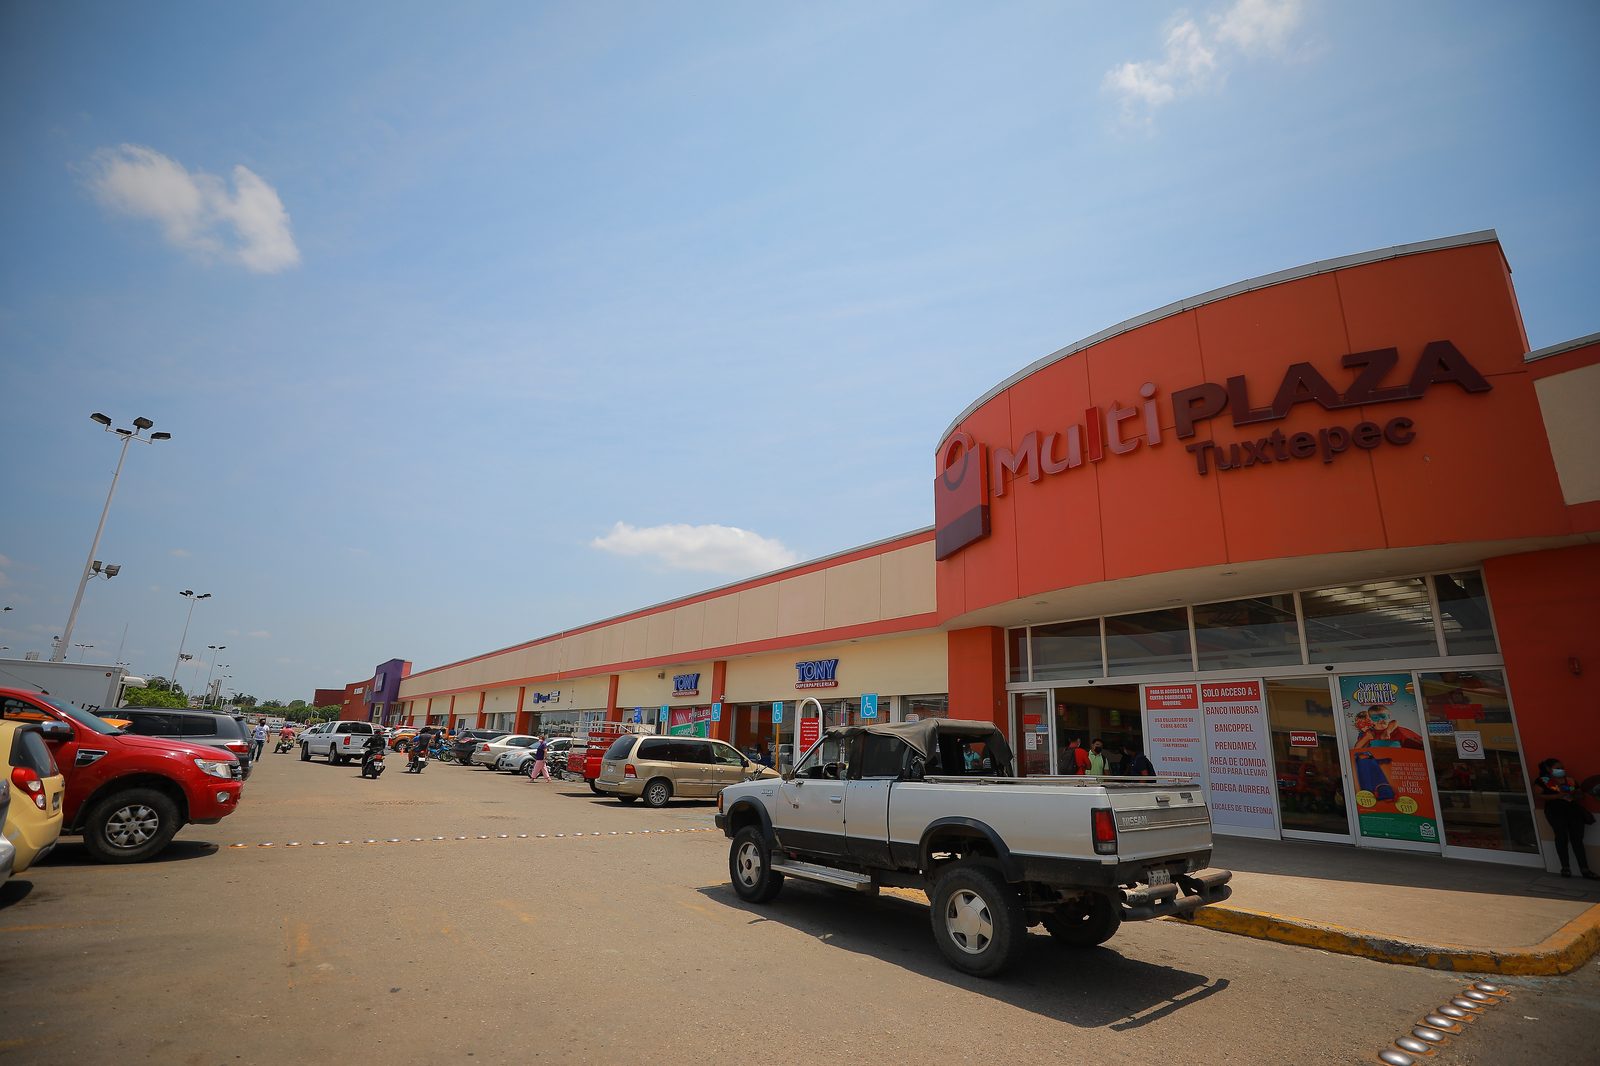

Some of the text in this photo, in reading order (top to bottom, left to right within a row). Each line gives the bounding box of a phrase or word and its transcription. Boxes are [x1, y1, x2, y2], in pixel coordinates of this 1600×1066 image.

[993, 340, 1492, 497] Multi PLAZA
[1186, 416, 1417, 476] Tuxtepec
[795, 658, 839, 681] TONY
[673, 673, 700, 690] TONY
[795, 681, 836, 689] SUPERPAPELERIAS
[1203, 688, 1219, 697] SOLO
[1220, 687, 1246, 696] ACCESO
[1358, 690, 1396, 704] GRANDE
[1206, 705, 1259, 715] BANCO INBURSA
[1214, 724, 1254, 732] BANCOPPEL
[1215, 741, 1257, 750] PRENDAMEX
[1210, 756, 1267, 767] AREA DE COMIDA
[1211, 782, 1270, 795] BODEGA AURRERA
[1212, 803, 1235, 811] LOCALES
[1244, 805, 1273, 814] TELEFONIA
[1122, 815, 1147, 826] NISSAN
